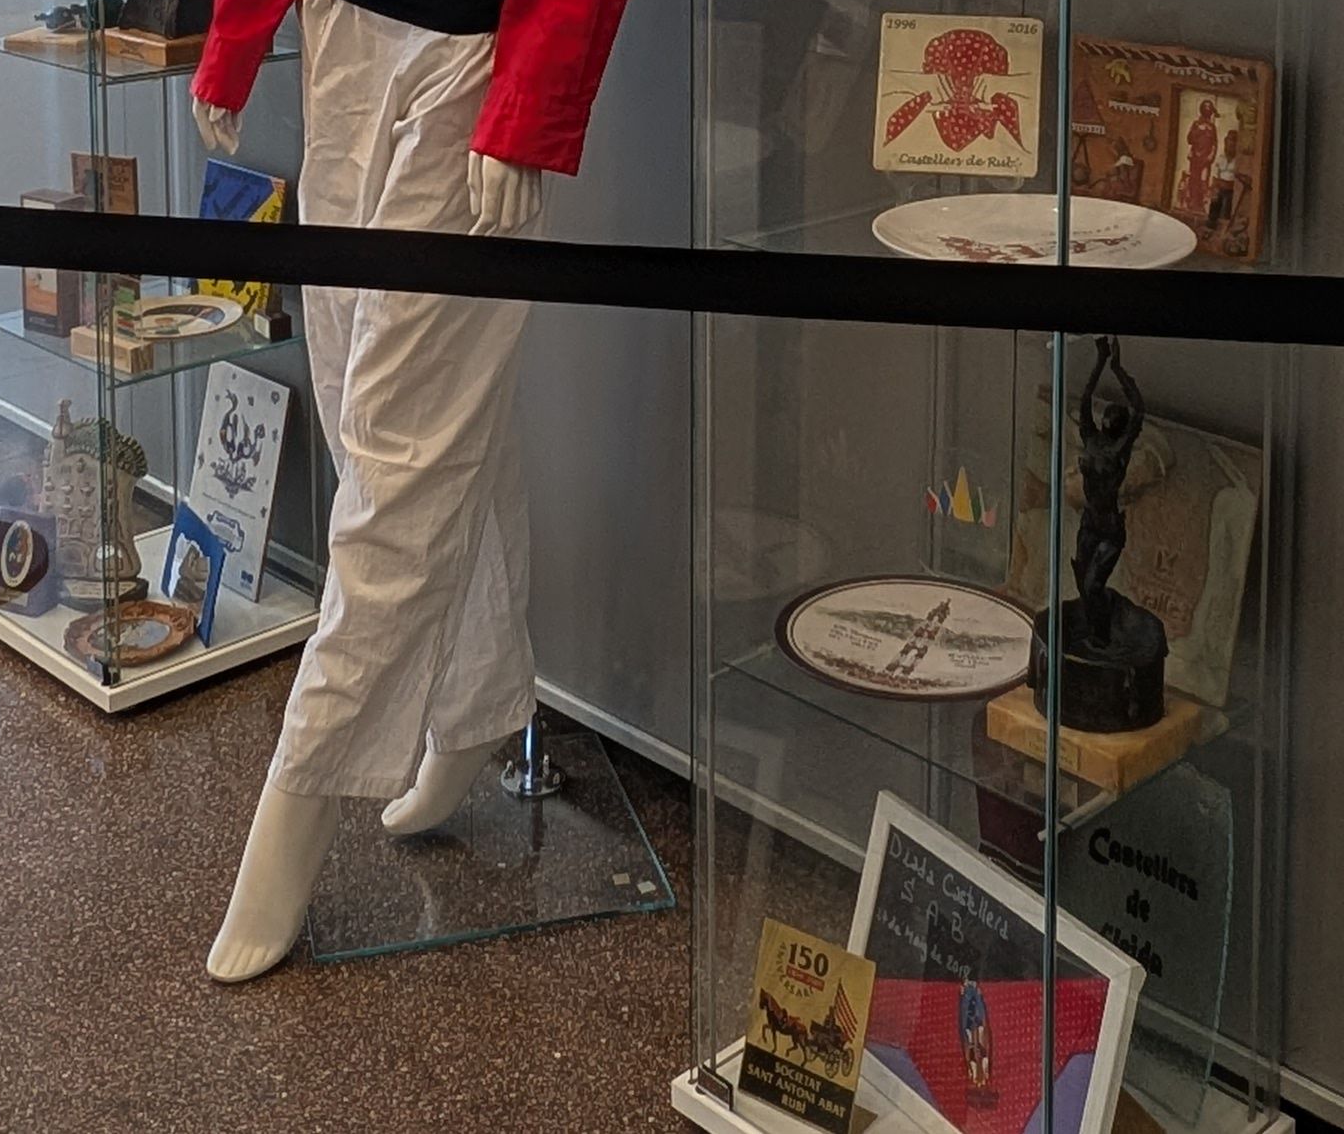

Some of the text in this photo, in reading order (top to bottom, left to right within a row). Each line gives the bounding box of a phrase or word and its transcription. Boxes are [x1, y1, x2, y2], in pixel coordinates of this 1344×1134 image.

[886, 18, 1039, 35] 1996 2016
[898, 153, 962, 167] Castellers
[965, 154, 986, 167] de
[1088, 827, 1199, 901] Castellers
[1125, 888, 1151, 923] de
[788, 942, 829, 977] 150
[746, 1063, 847, 1118] SANT ANTONI ABAT
[775, 1061, 822, 1093] SOCIETAT
